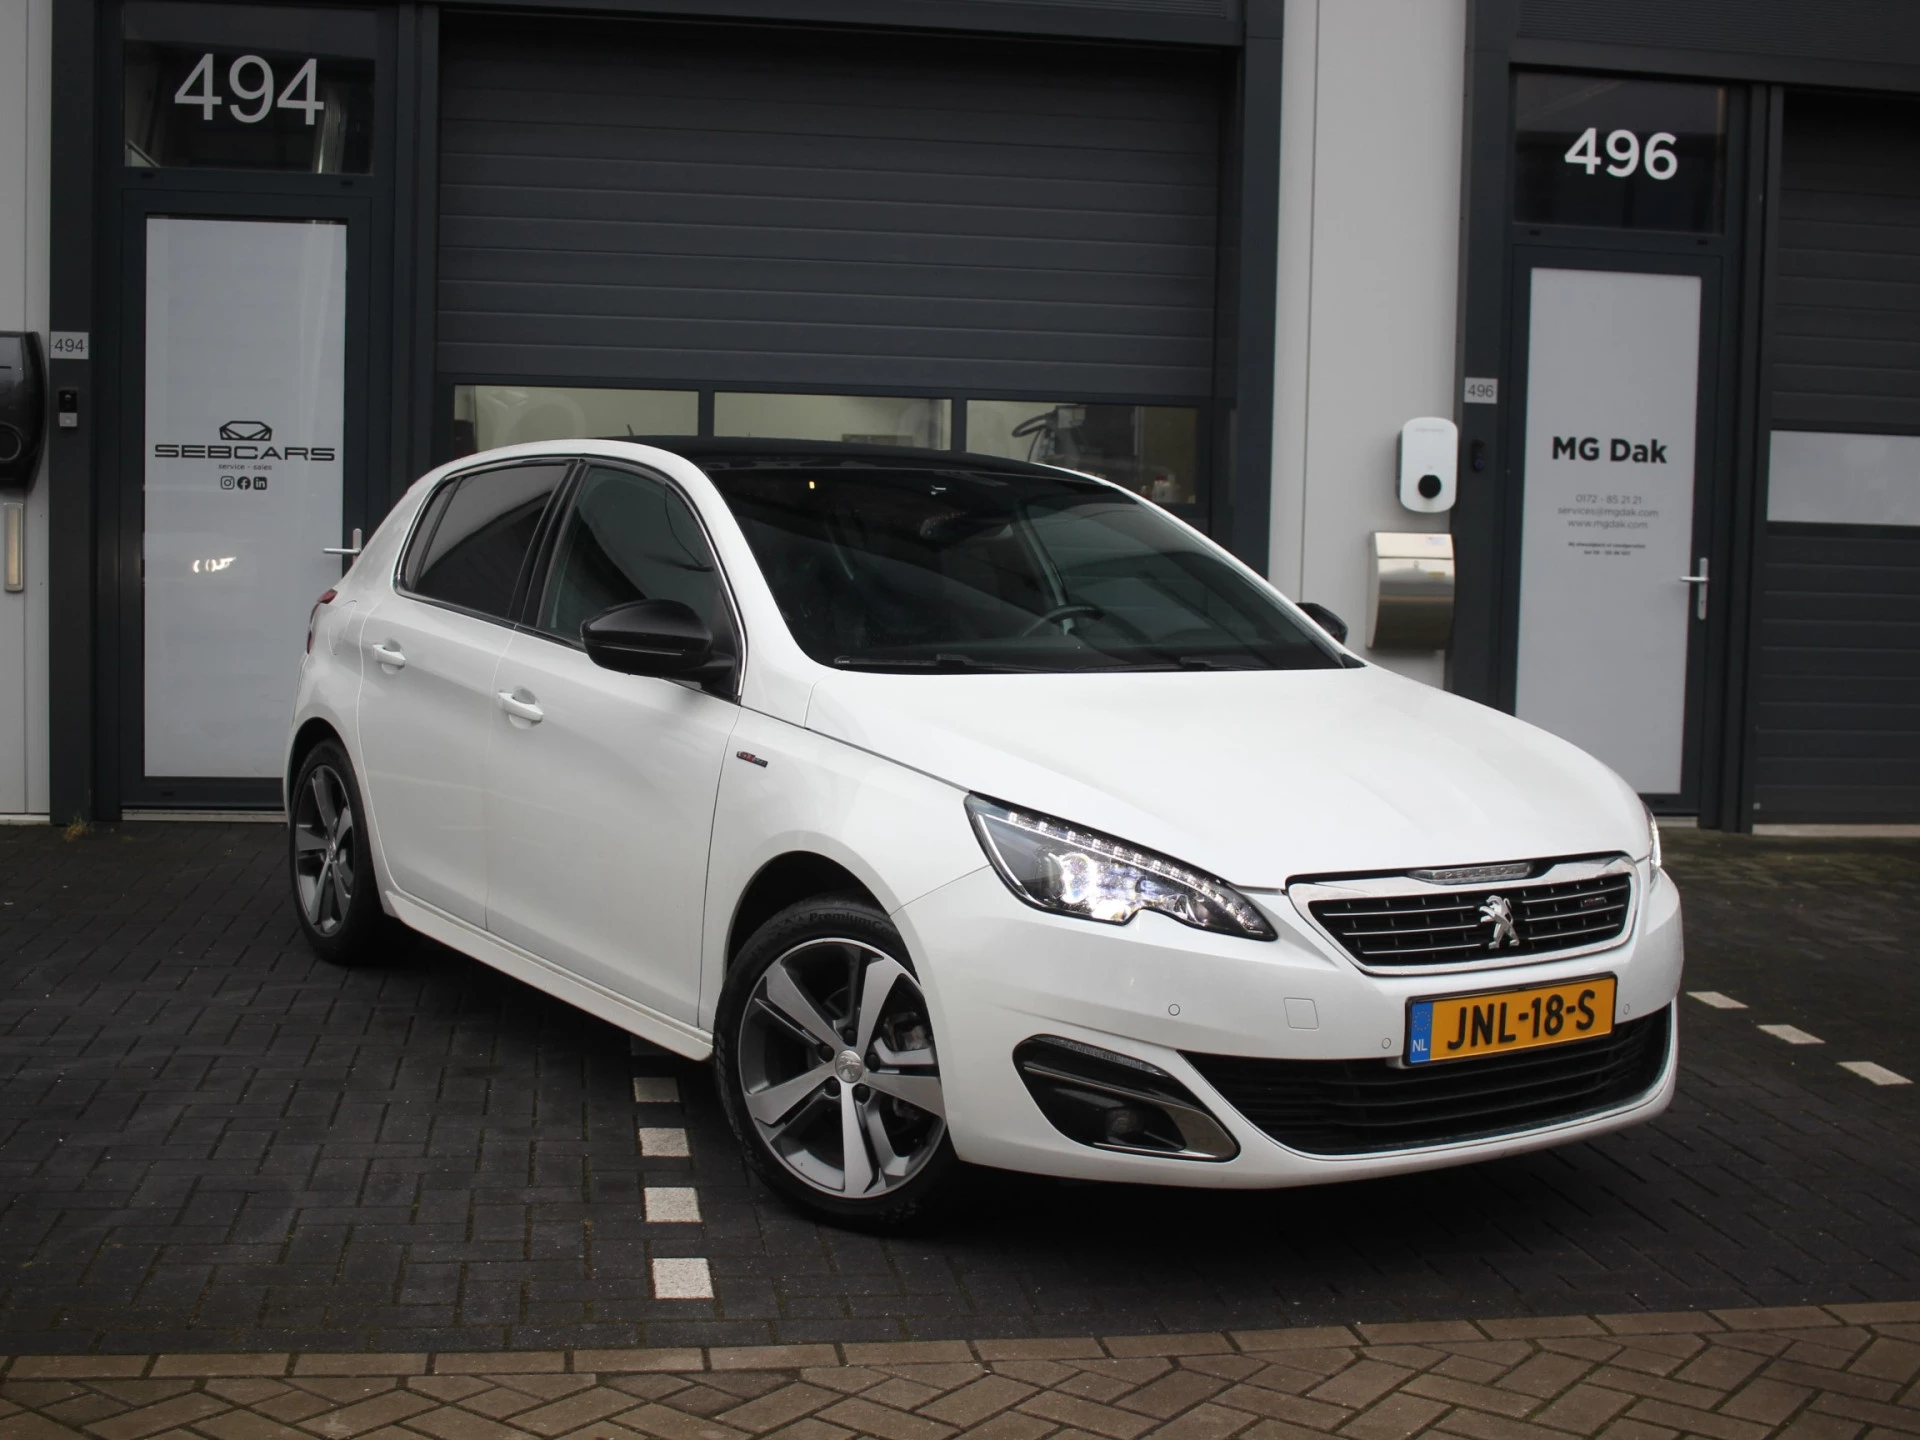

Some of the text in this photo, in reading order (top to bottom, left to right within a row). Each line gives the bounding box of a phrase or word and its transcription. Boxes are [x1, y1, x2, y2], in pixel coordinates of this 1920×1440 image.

[174, 53, 325, 126] 494
[1564, 127, 1678, 180] 496
[54, 338, 85, 353] 494
[1468, 384, 1494, 398] 496
[154, 444, 336, 462] SEBCARS
[1552, 436, 1668, 464] MG Dak
[218, 463, 245, 471] service
[1447, 989, 1596, 1050] JNL-18-S
[1412, 1039, 1427, 1053] NL
